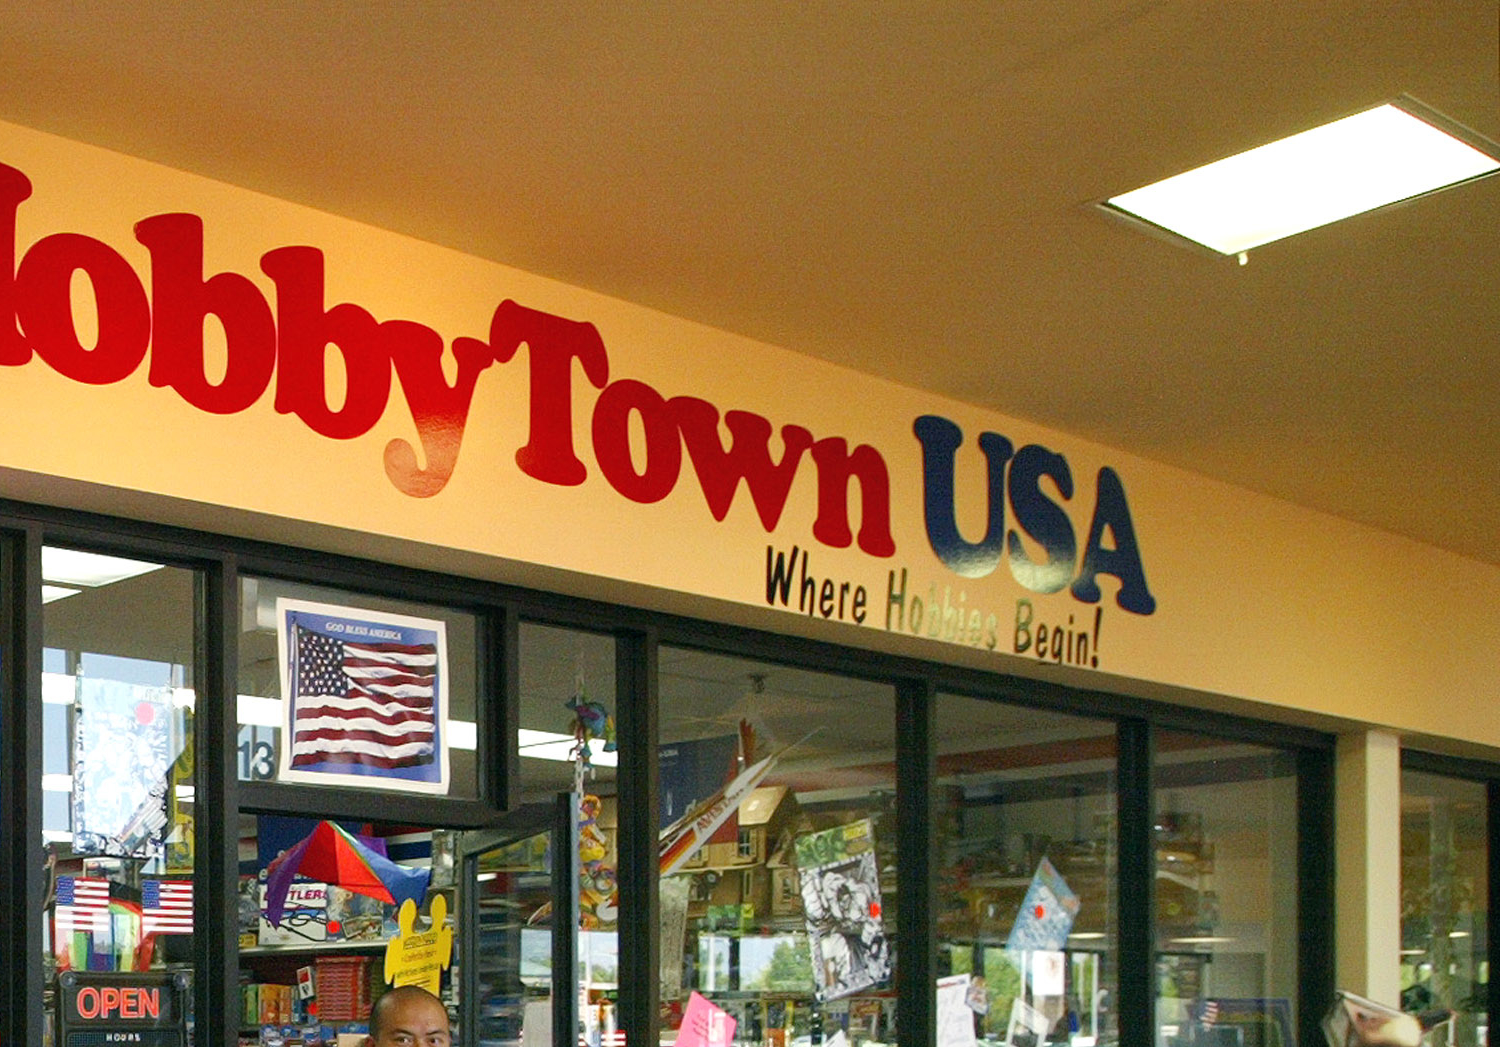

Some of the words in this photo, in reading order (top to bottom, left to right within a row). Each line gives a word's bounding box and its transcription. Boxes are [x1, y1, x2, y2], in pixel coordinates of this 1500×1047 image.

[913, 414, 1156, 615] USA
[765, 545, 867, 623] Where
[884, 567, 998, 652] Hobbies
[1012, 597, 1103, 668] Begin!
[325, 621, 345, 633] GOD
[345, 624, 369, 636] BLESS
[368, 628, 402, 641] AMERICA
[77, 987, 160, 1019] OPEN
[106, 1032, 142, 1043] HOURS
